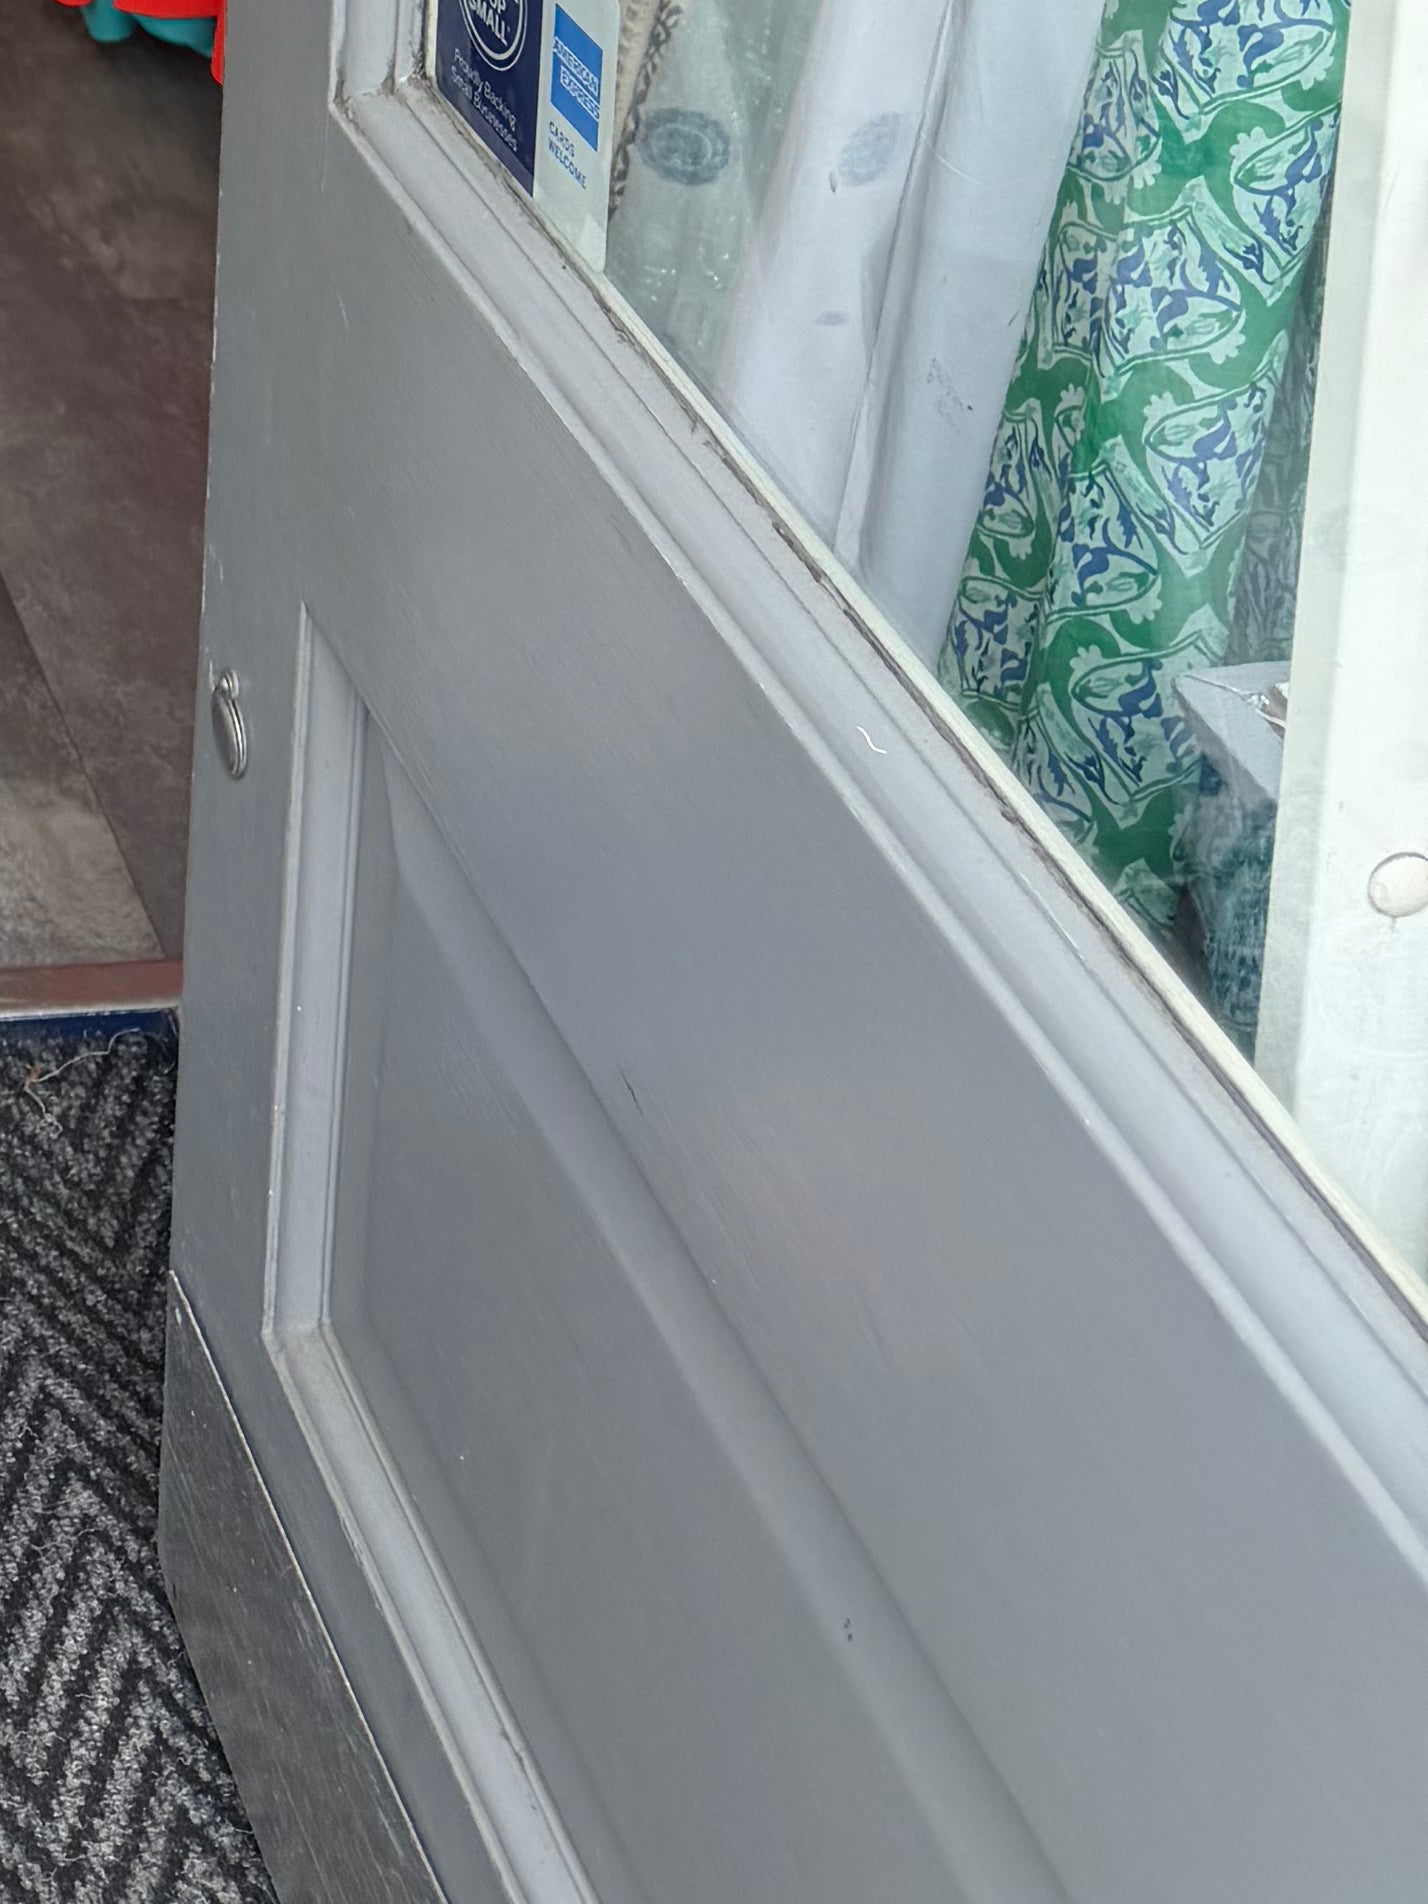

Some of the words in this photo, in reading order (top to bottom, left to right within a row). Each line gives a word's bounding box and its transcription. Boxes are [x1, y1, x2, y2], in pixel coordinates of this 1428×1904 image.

[552, 35, 599, 96] AMERICAN
[559, 65, 601, 121] EXPRESS
[547, 138, 587, 190] WELCOME
[548, 120, 576, 159] CARDS
